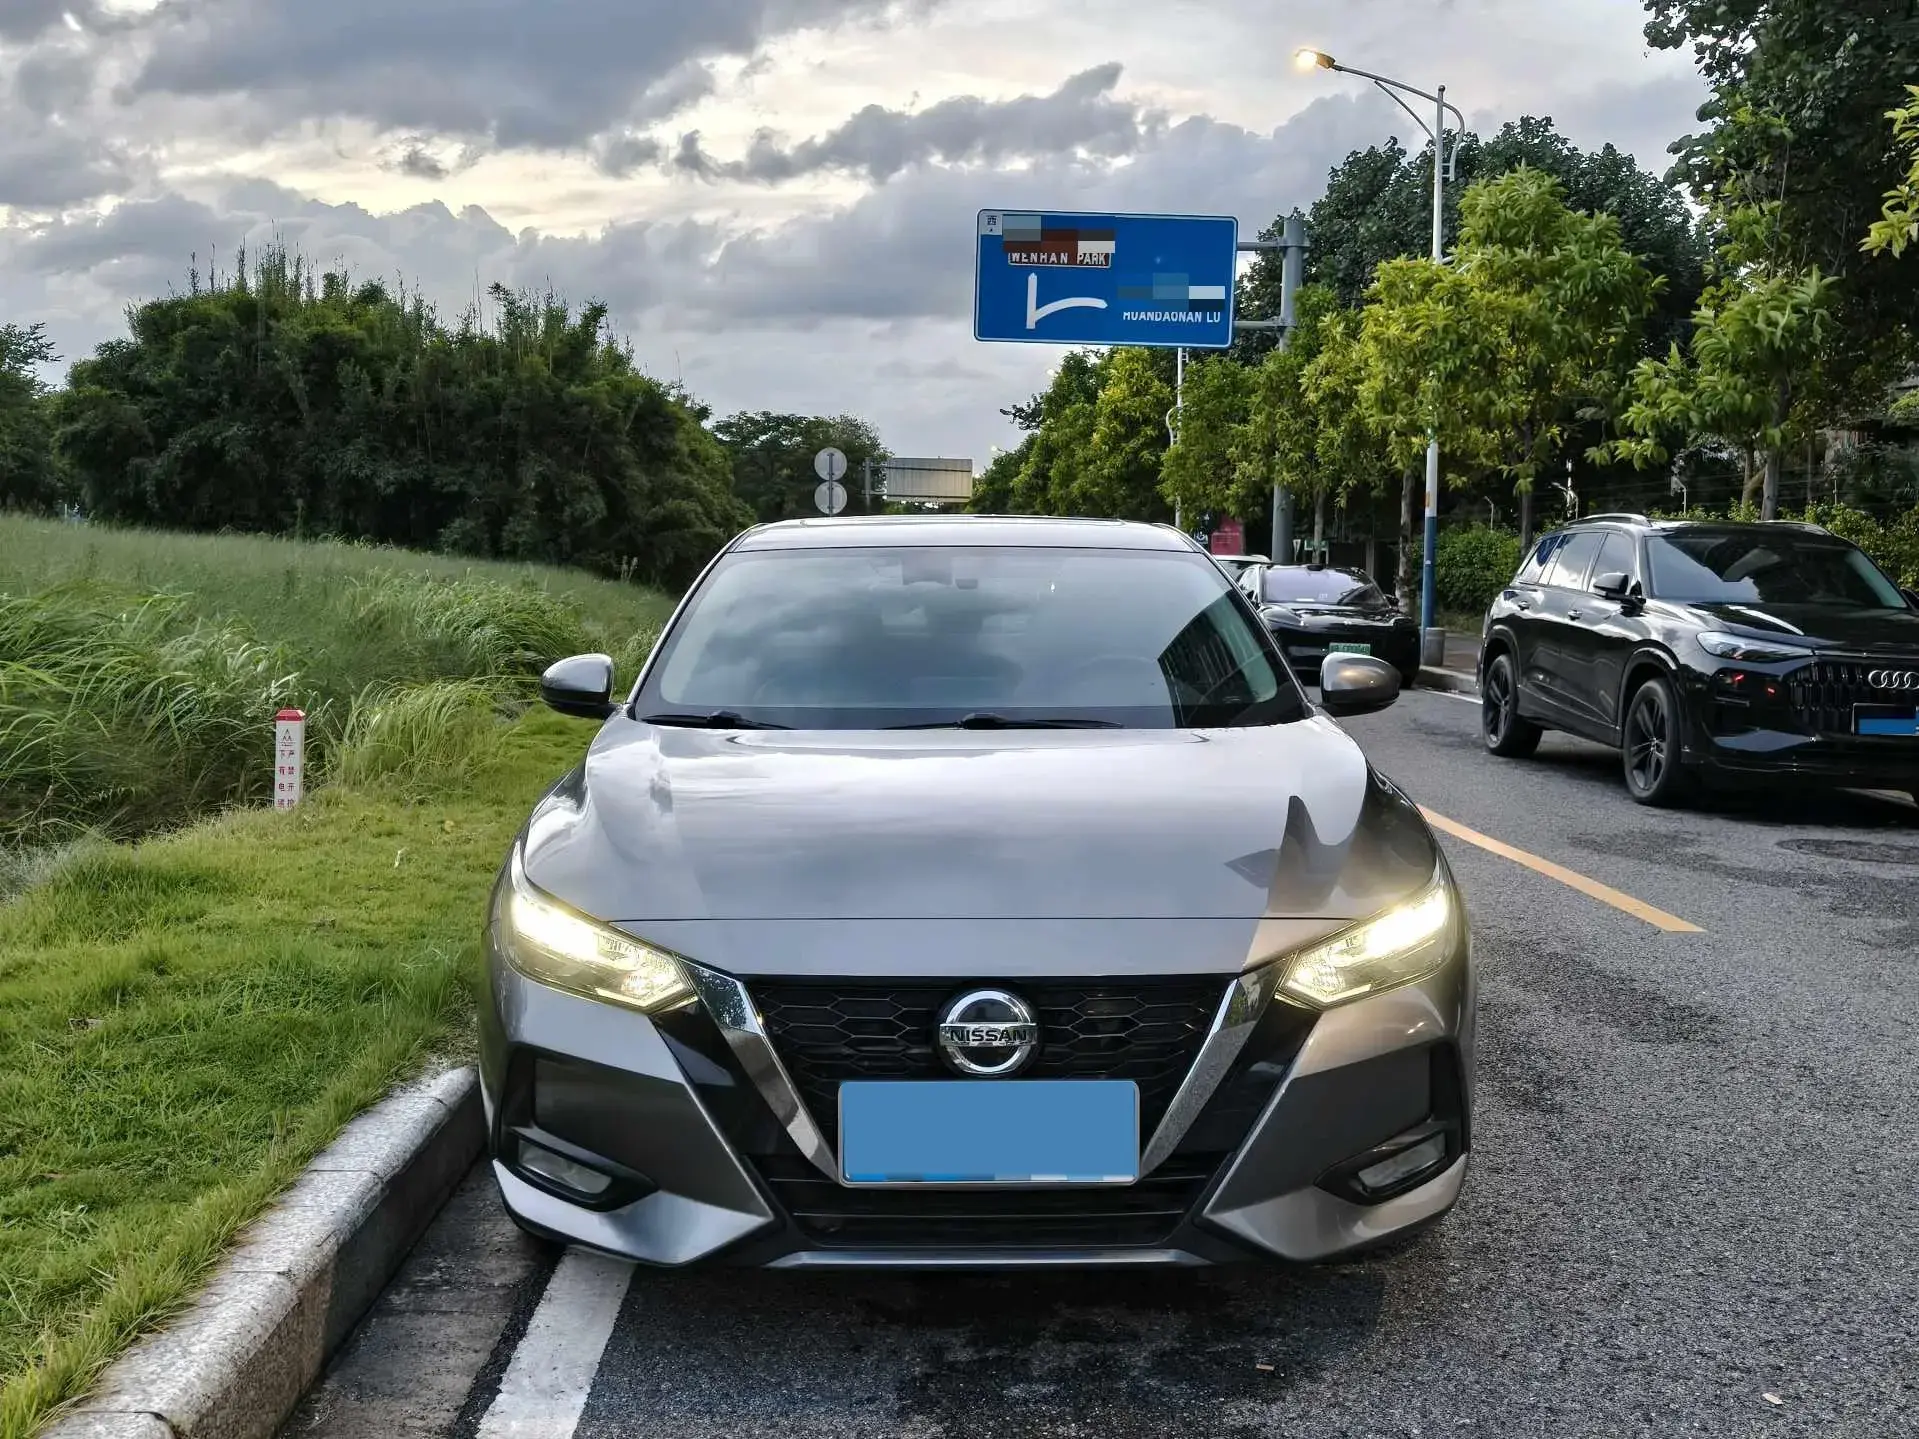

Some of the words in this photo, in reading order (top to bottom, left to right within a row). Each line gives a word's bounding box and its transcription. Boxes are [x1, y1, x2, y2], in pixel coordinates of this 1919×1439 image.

[1077, 252, 1106, 265] PARK
[1206, 311, 1221, 323] LU
[950, 1029, 1027, 1042] NISSAN
